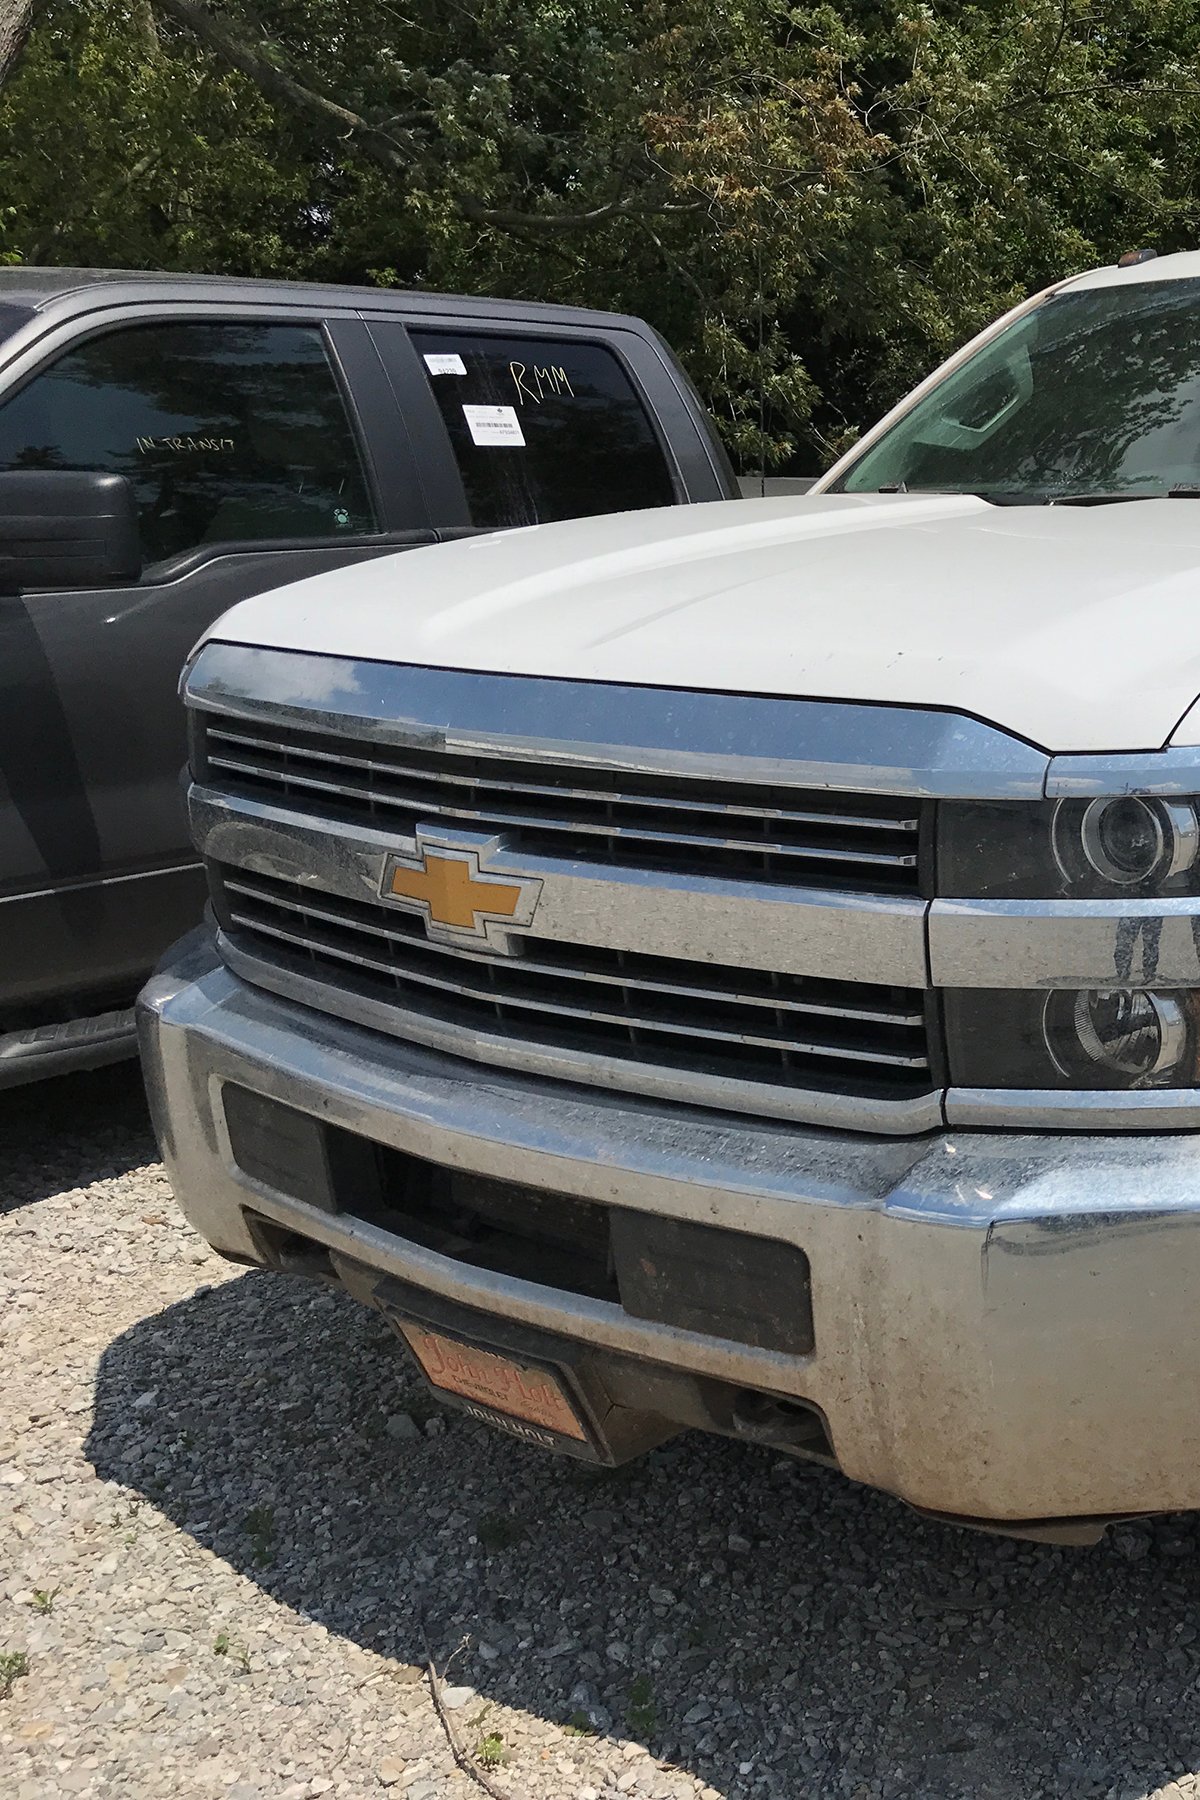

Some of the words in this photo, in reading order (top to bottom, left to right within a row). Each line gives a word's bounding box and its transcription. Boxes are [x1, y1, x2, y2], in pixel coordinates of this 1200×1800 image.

[509, 361, 574, 405] RMM
[136, 436, 156, 454] IN
[162, 437, 236, 452] TRANSIT
